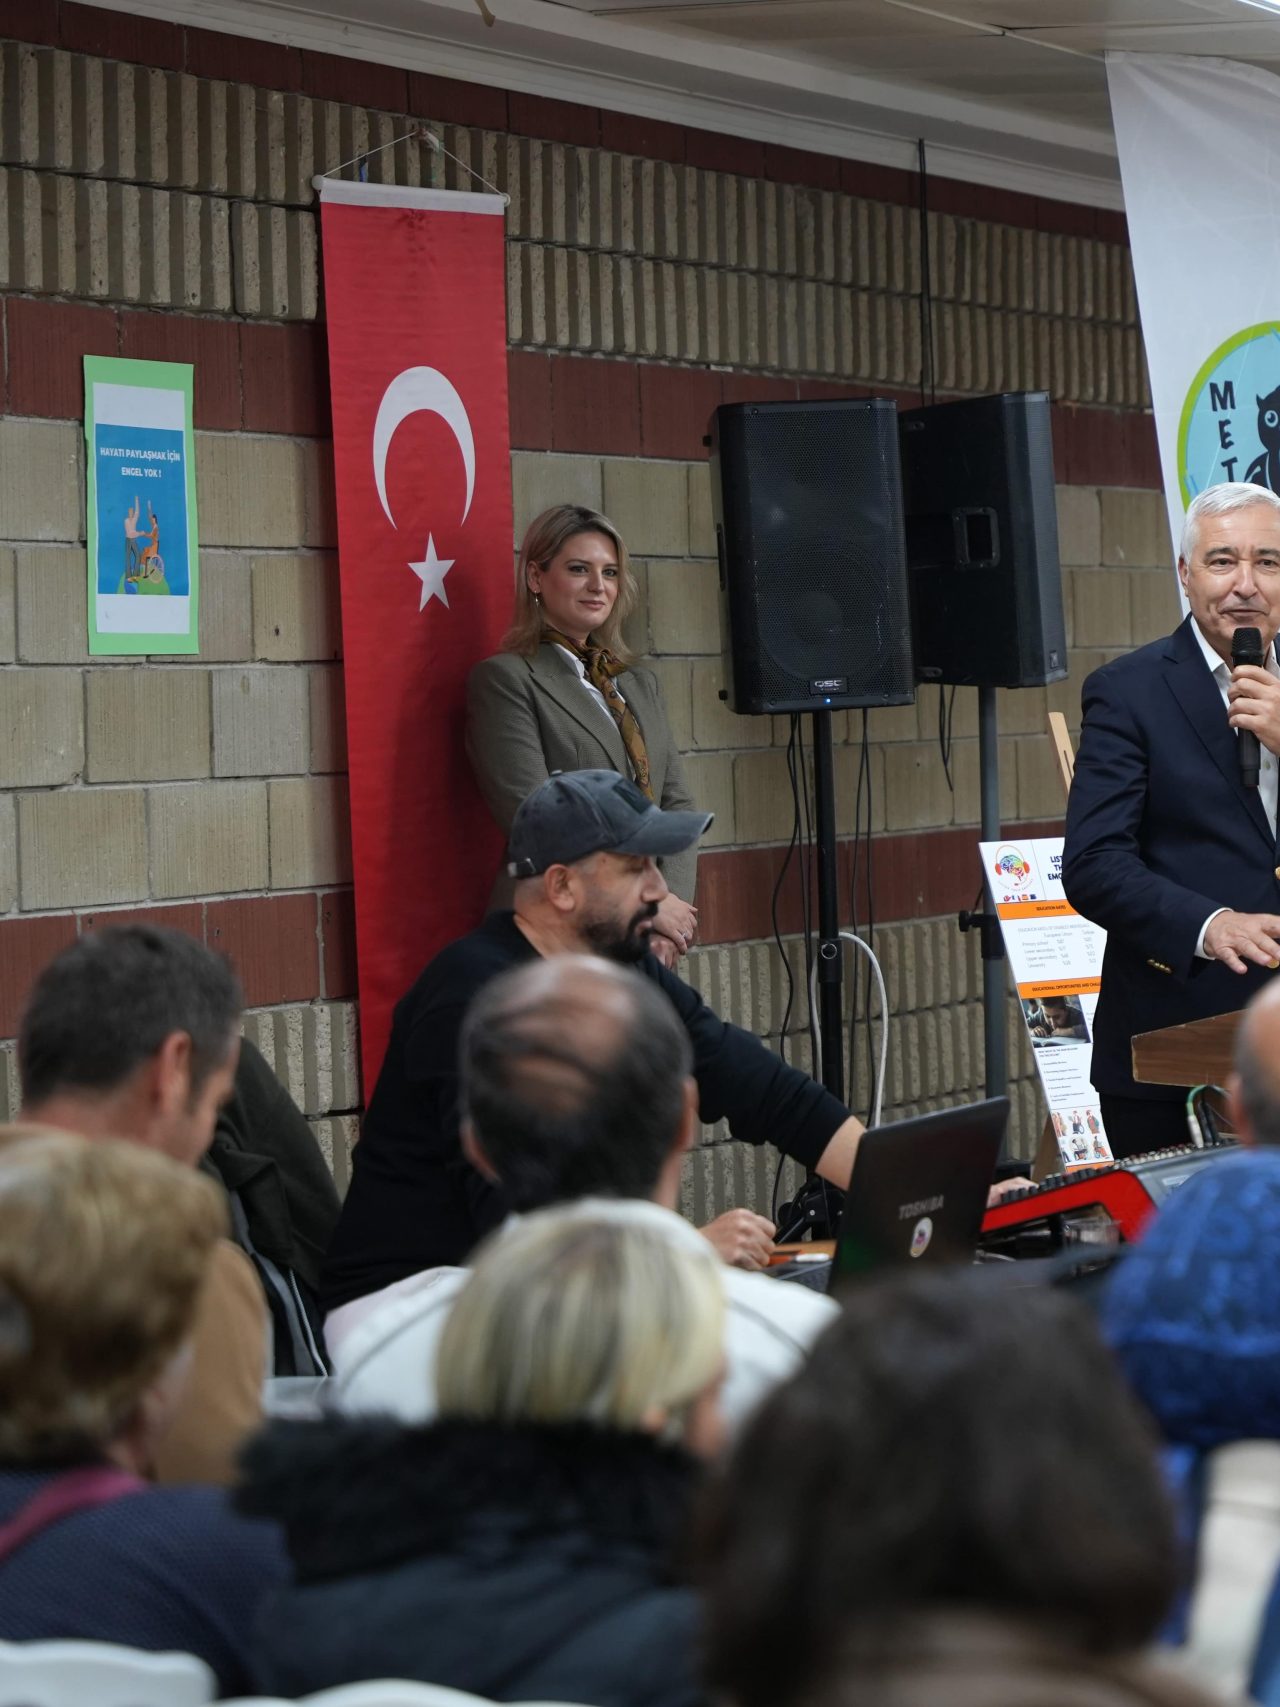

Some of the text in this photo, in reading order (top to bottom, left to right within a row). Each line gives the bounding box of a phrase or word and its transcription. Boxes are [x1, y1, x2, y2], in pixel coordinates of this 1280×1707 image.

[100, 447, 125, 457] HAYATI
[126, 449, 166, 461] PAYLAŞMAK
[121, 467, 143, 477] ENGEL
[144, 469, 158, 478] YOK
[814, 679, 844, 688] QSC
[898, 1193, 945, 1221] TOSHIBA
